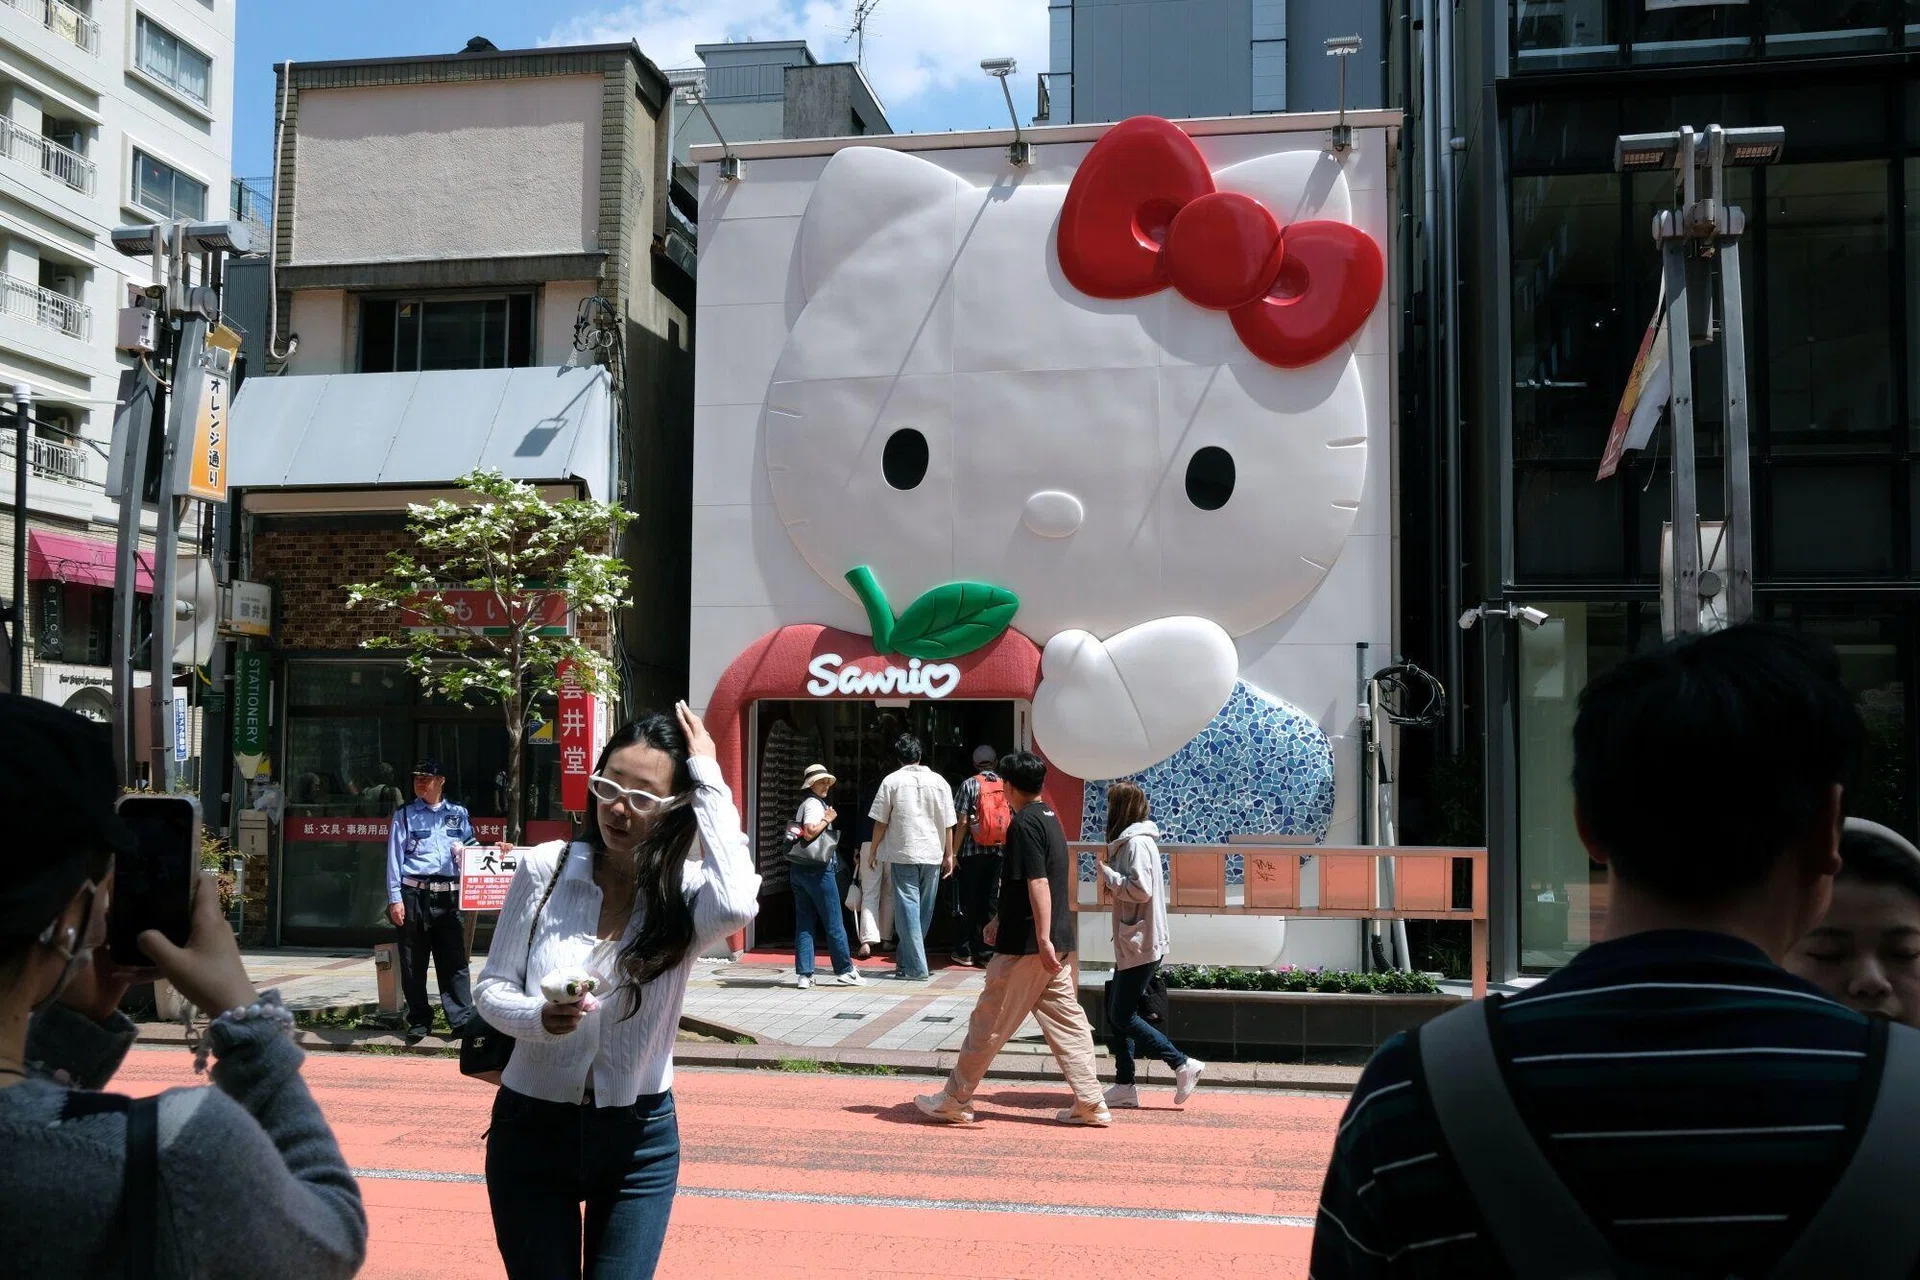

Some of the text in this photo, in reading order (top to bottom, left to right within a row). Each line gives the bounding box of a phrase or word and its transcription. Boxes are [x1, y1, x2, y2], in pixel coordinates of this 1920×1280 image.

[208, 378, 221, 489] オレンジ通り
[48, 585, 58, 645] erica
[423, 597, 546, 622] もい堂
[246, 658, 260, 745] STATIONERY
[806, 653, 961, 699] Sanrio
[561, 667, 587, 775] 雲井堂
[303, 823, 389, 836] 紙・文具・事務用品
